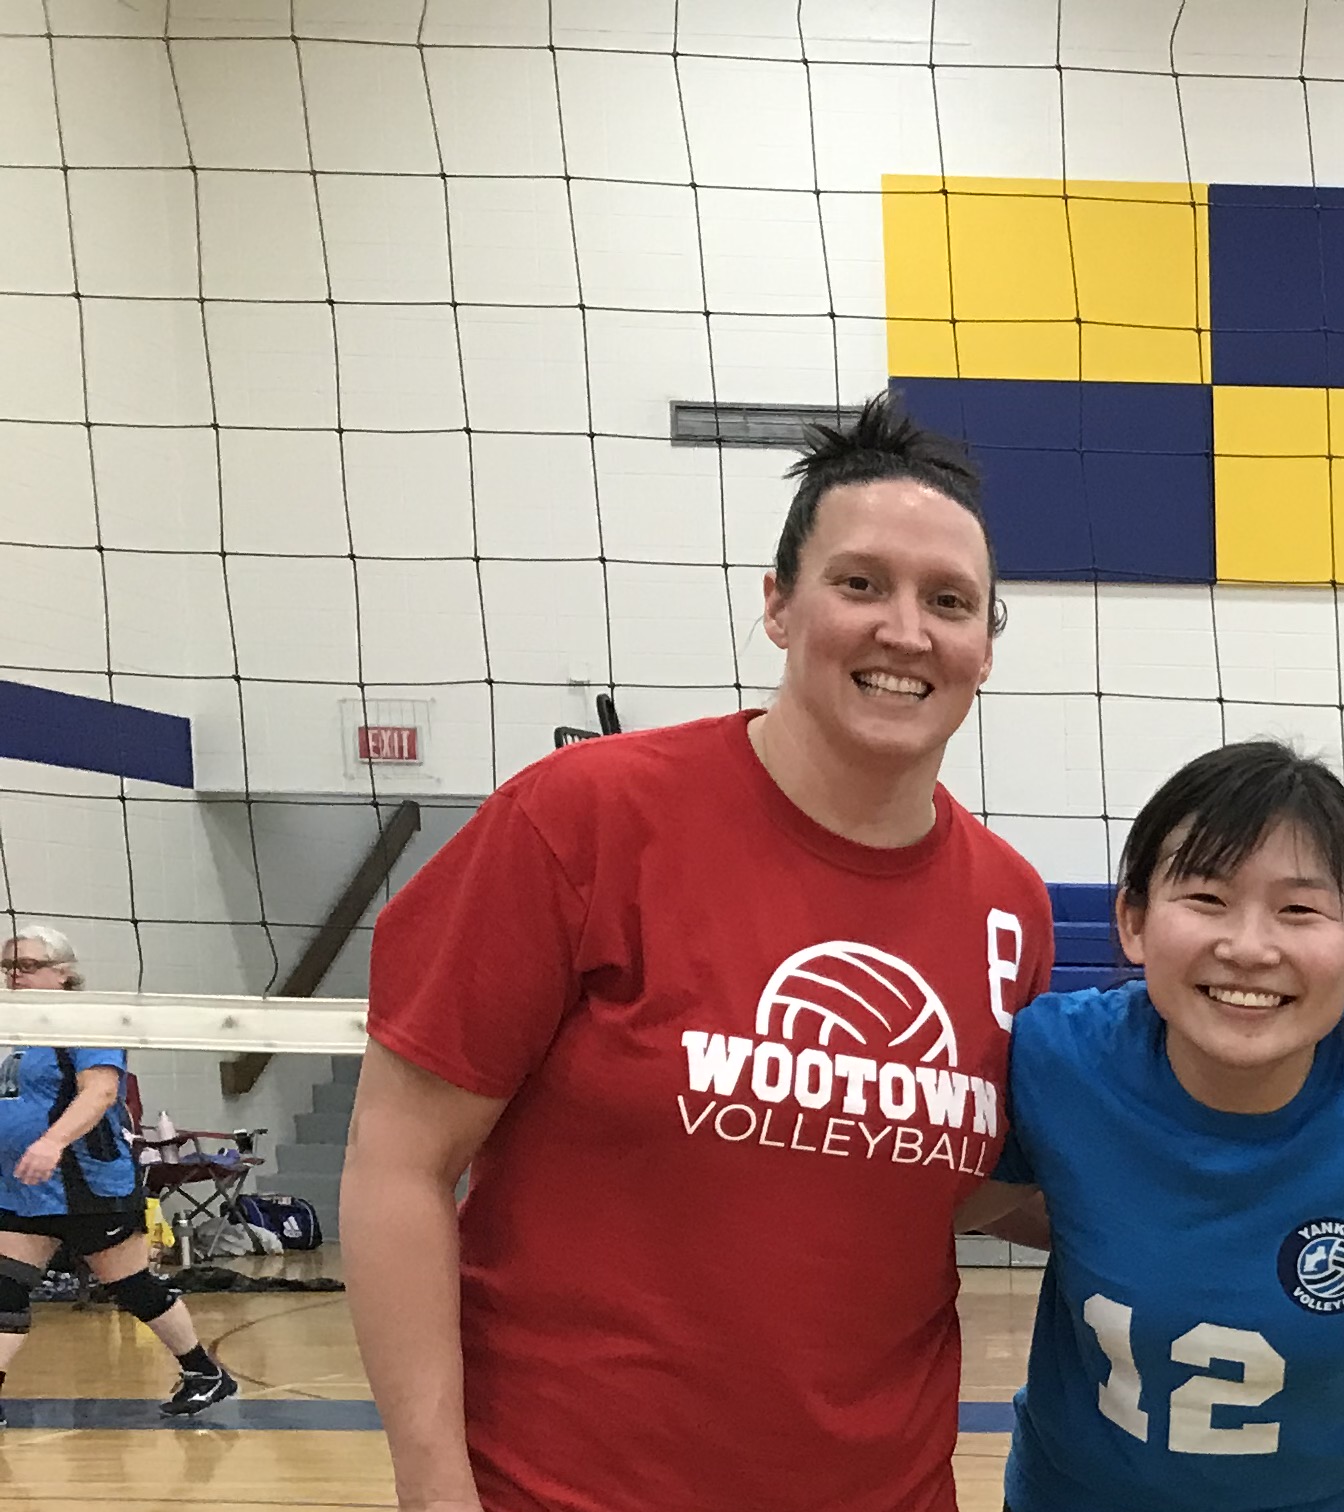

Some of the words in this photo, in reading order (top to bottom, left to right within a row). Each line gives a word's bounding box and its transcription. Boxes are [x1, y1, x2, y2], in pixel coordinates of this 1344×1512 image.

[368, 730, 409, 758] EXIT
[681, 1030, 998, 1138] WOOTOWN
[677, 1094, 990, 1177] VOLLEYBALL
[1083, 1292, 1286, 1455] 12
